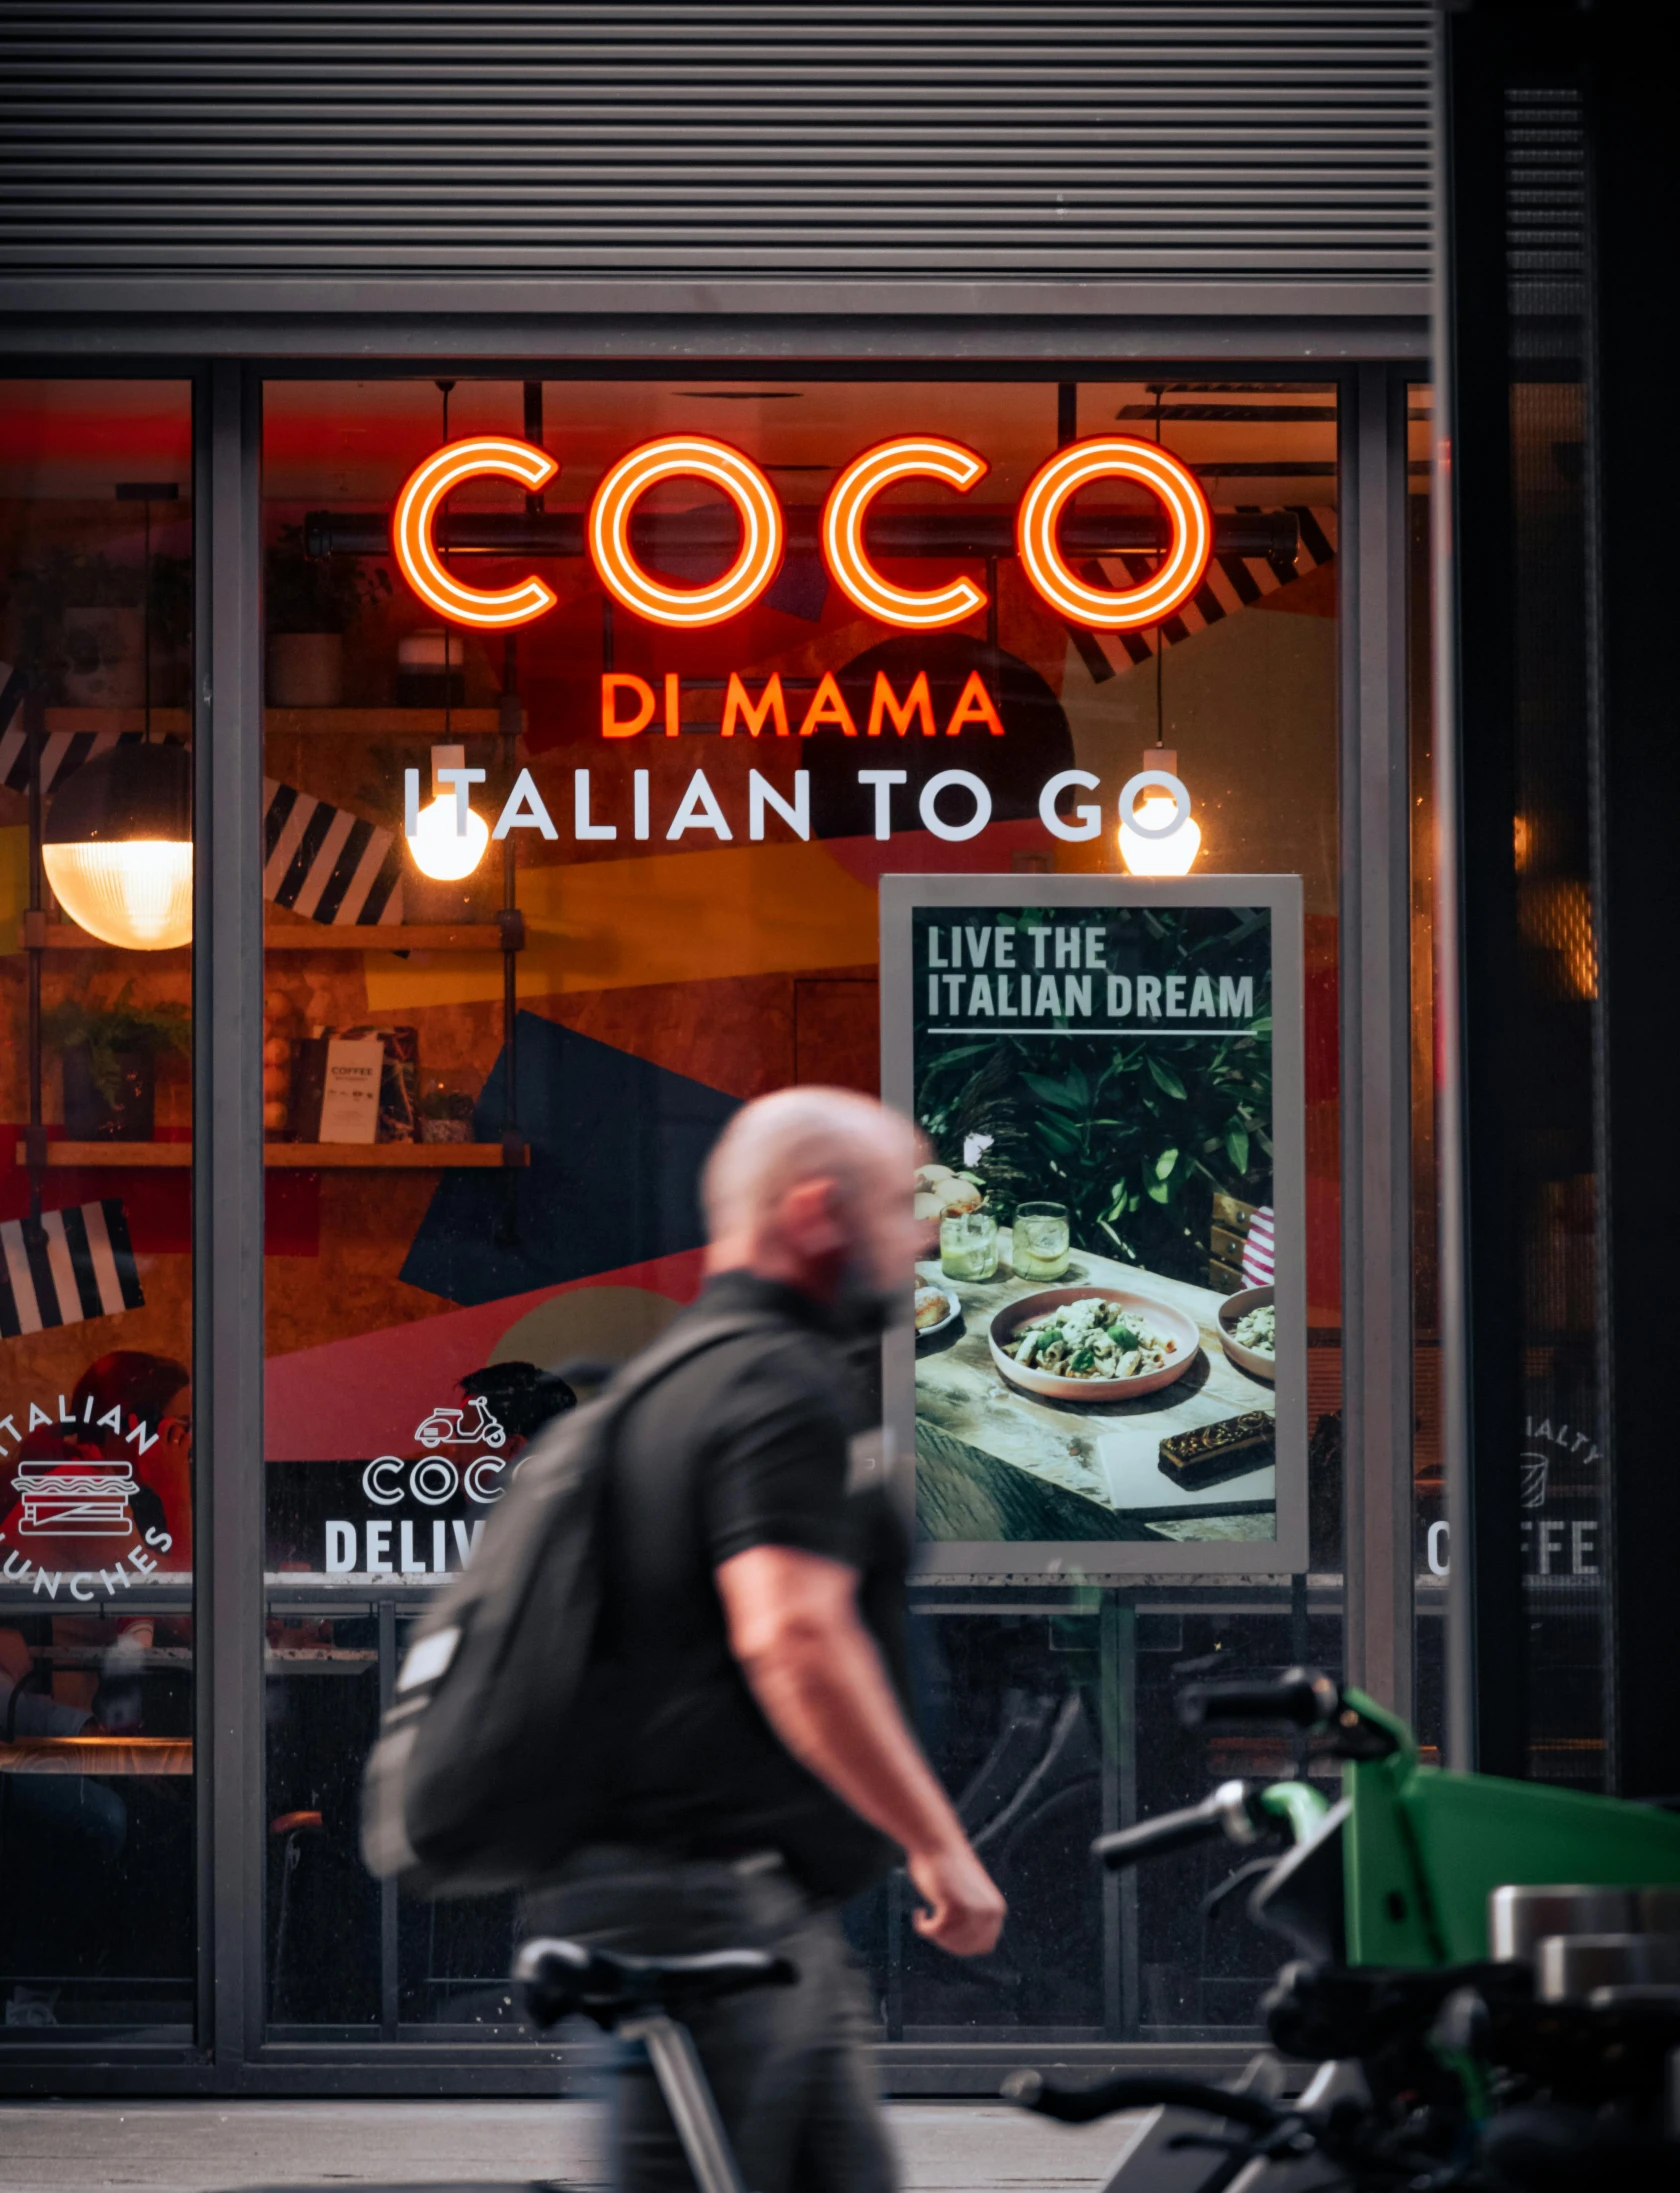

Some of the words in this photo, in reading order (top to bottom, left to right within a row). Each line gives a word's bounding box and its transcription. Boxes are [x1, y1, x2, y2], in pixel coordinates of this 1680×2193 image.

[393, 435, 1211, 631] COCO
[601, 672, 681, 739] DI
[720, 670, 1006, 739] MAMA
[404, 767, 811, 841] ITALIAN
[858, 769, 992, 842] TO
[1038, 769, 1192, 842] GO
[928, 926, 1017, 968] LIVE
[1027, 926, 1107, 969] THE
[928, 974, 1092, 1017] ITALIAN
[1107, 975, 1253, 1018] DREAM
[1525, 1415, 1604, 1464] IALTY
[0, 1526, 173, 1602] UNCHES
[325, 1520, 487, 1573] DELIV
